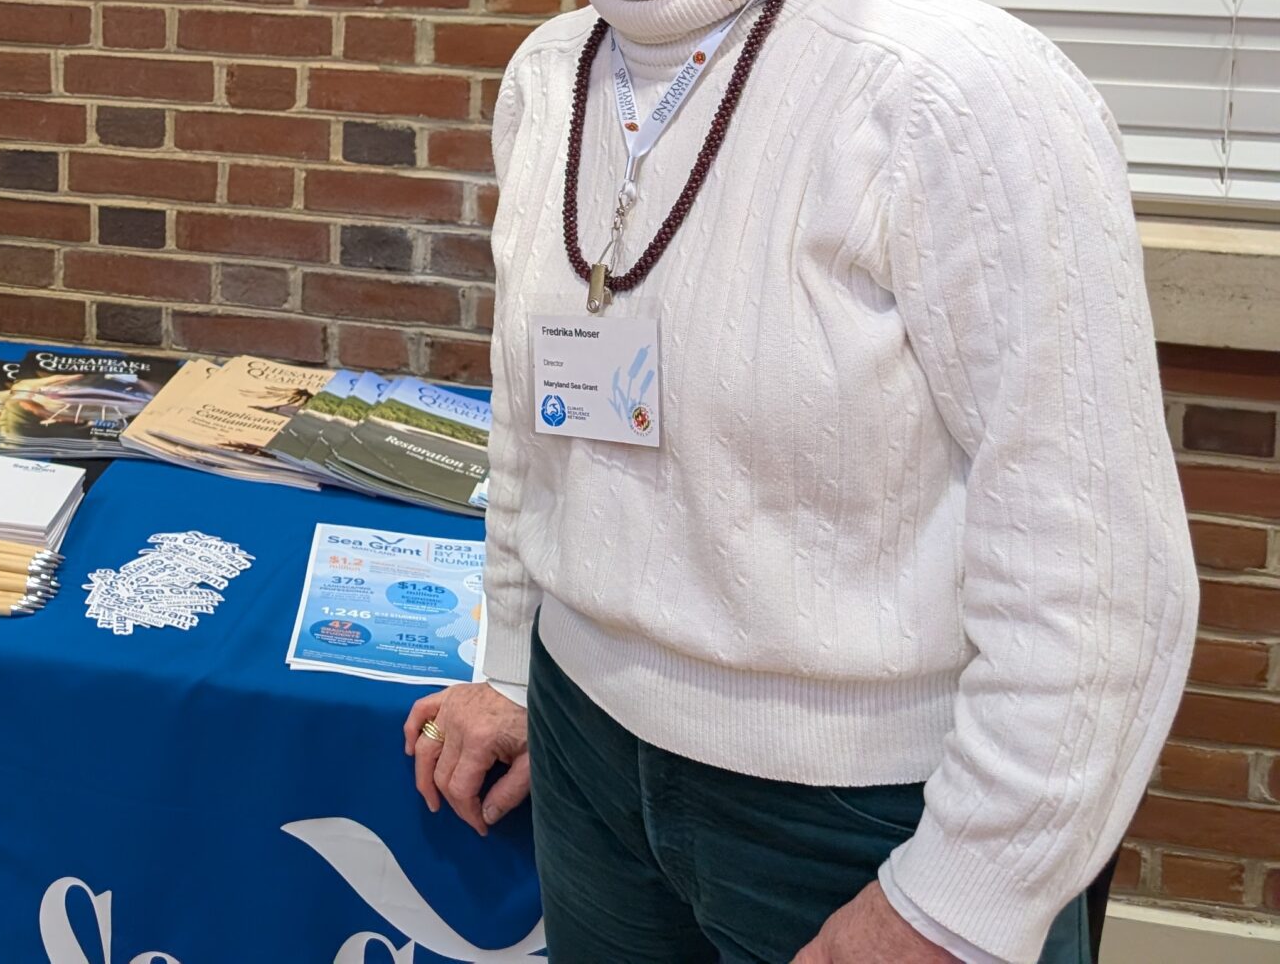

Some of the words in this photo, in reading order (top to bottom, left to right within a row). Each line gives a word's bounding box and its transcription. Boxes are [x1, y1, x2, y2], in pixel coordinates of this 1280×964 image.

[618, 68, 637, 121] MARYLAND
[652, 62, 694, 122] MARYLAND
[667, 68, 699, 114] UNIVERSITY
[660, 114, 668, 124] OF
[542, 326, 573, 338] Fredrika
[574, 328, 600, 339] Moser
[35, 352, 151, 371] CHESAPEAKE
[39, 359, 139, 375] QUARTERLY
[543, 359, 564, 367] Director
[543, 379, 570, 390] Maryland
[570, 382, 582, 390] Sea
[582, 383, 598, 391] Grant
[202, 403, 285, 427] Complicated
[384, 435, 464, 468] Restoration
[151, 535, 178, 543] Sea
[183, 537, 225, 552] Grant
[327, 535, 363, 546] Sea
[369, 541, 422, 557] Grant
[434, 543, 472, 552] 2023
[351, 545, 396, 557] MARYLAND
[434, 550, 453, 558] BY
[460, 552, 484, 561] THE
[172, 545, 196, 556] Sea
[198, 555, 238, 576] Grant
[329, 555, 364, 566] $1.2
[148, 563, 177, 577] Sea
[185, 567, 226, 588] Grant
[331, 575, 365, 586] 379
[133, 588, 165, 596] Sea
[169, 587, 214, 597] Grant
[397, 581, 446, 594] $1.45
[328, 619, 353, 629] 47
[396, 633, 430, 644] 153
